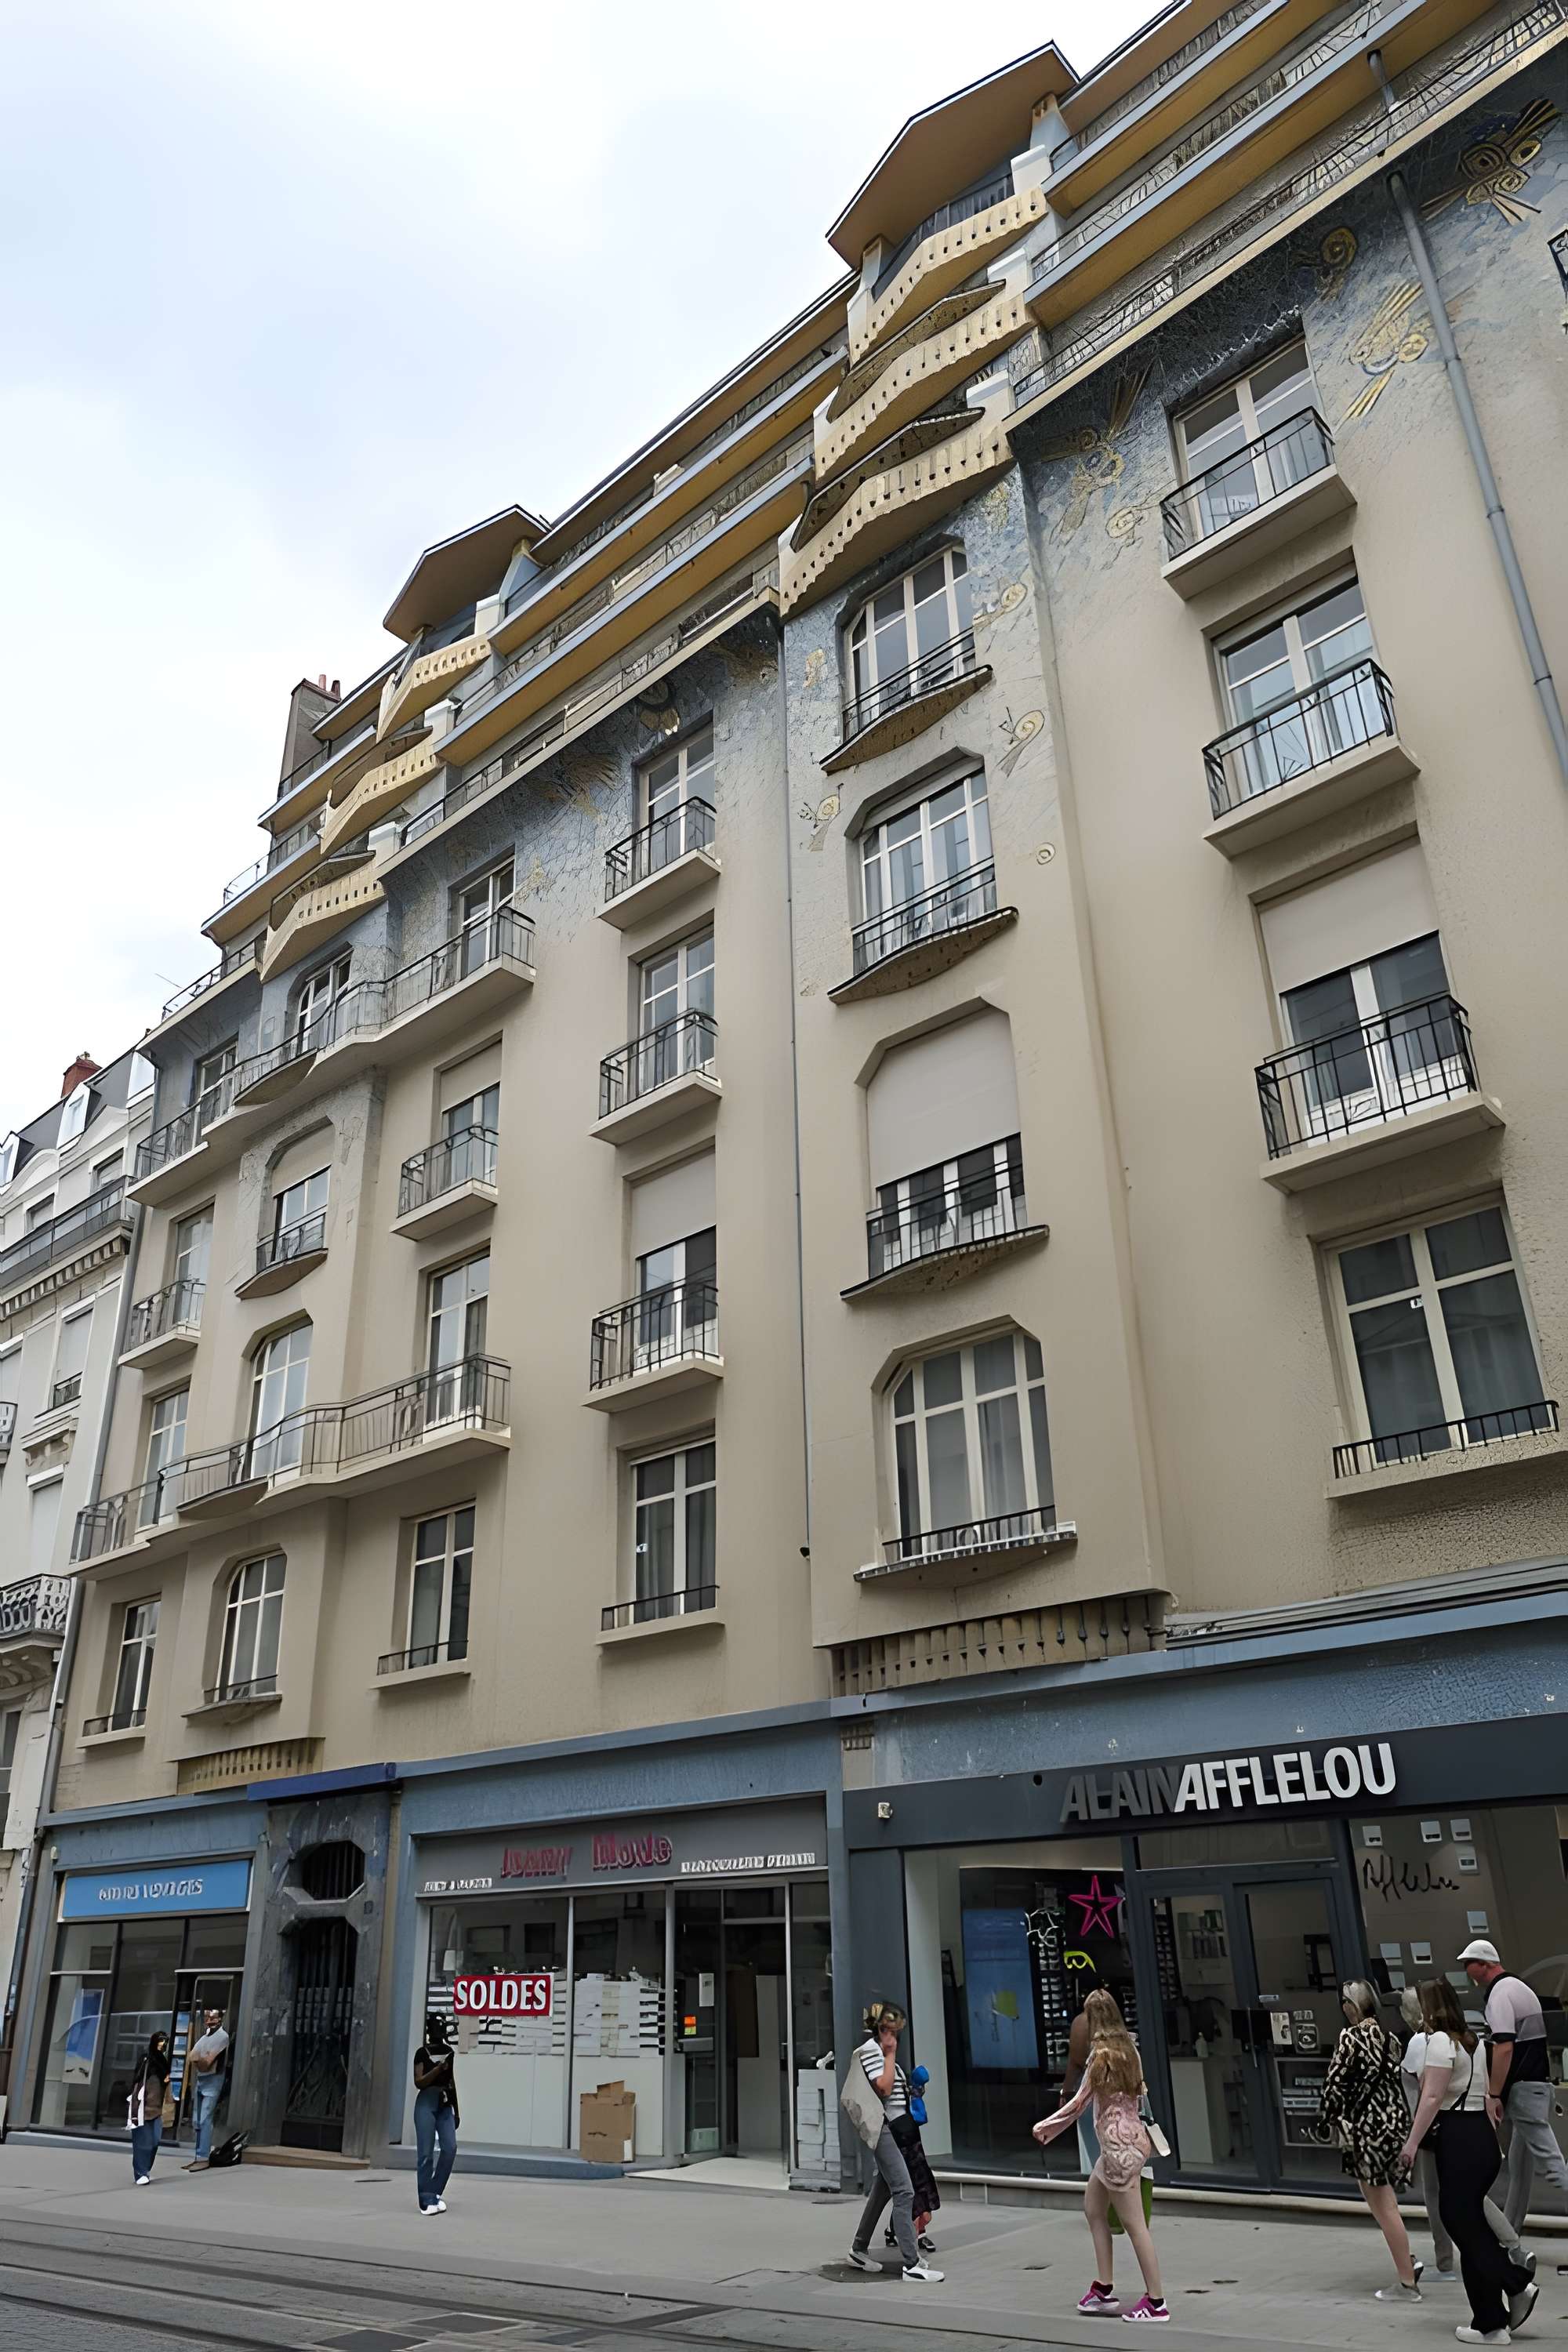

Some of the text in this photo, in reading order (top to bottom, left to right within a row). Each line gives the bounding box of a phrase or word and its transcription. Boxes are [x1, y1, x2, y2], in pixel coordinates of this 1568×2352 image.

[1060, 1743, 1396, 1823] ALAIN AFFLELOU
[455, 1979, 546, 2011] SOLDES
